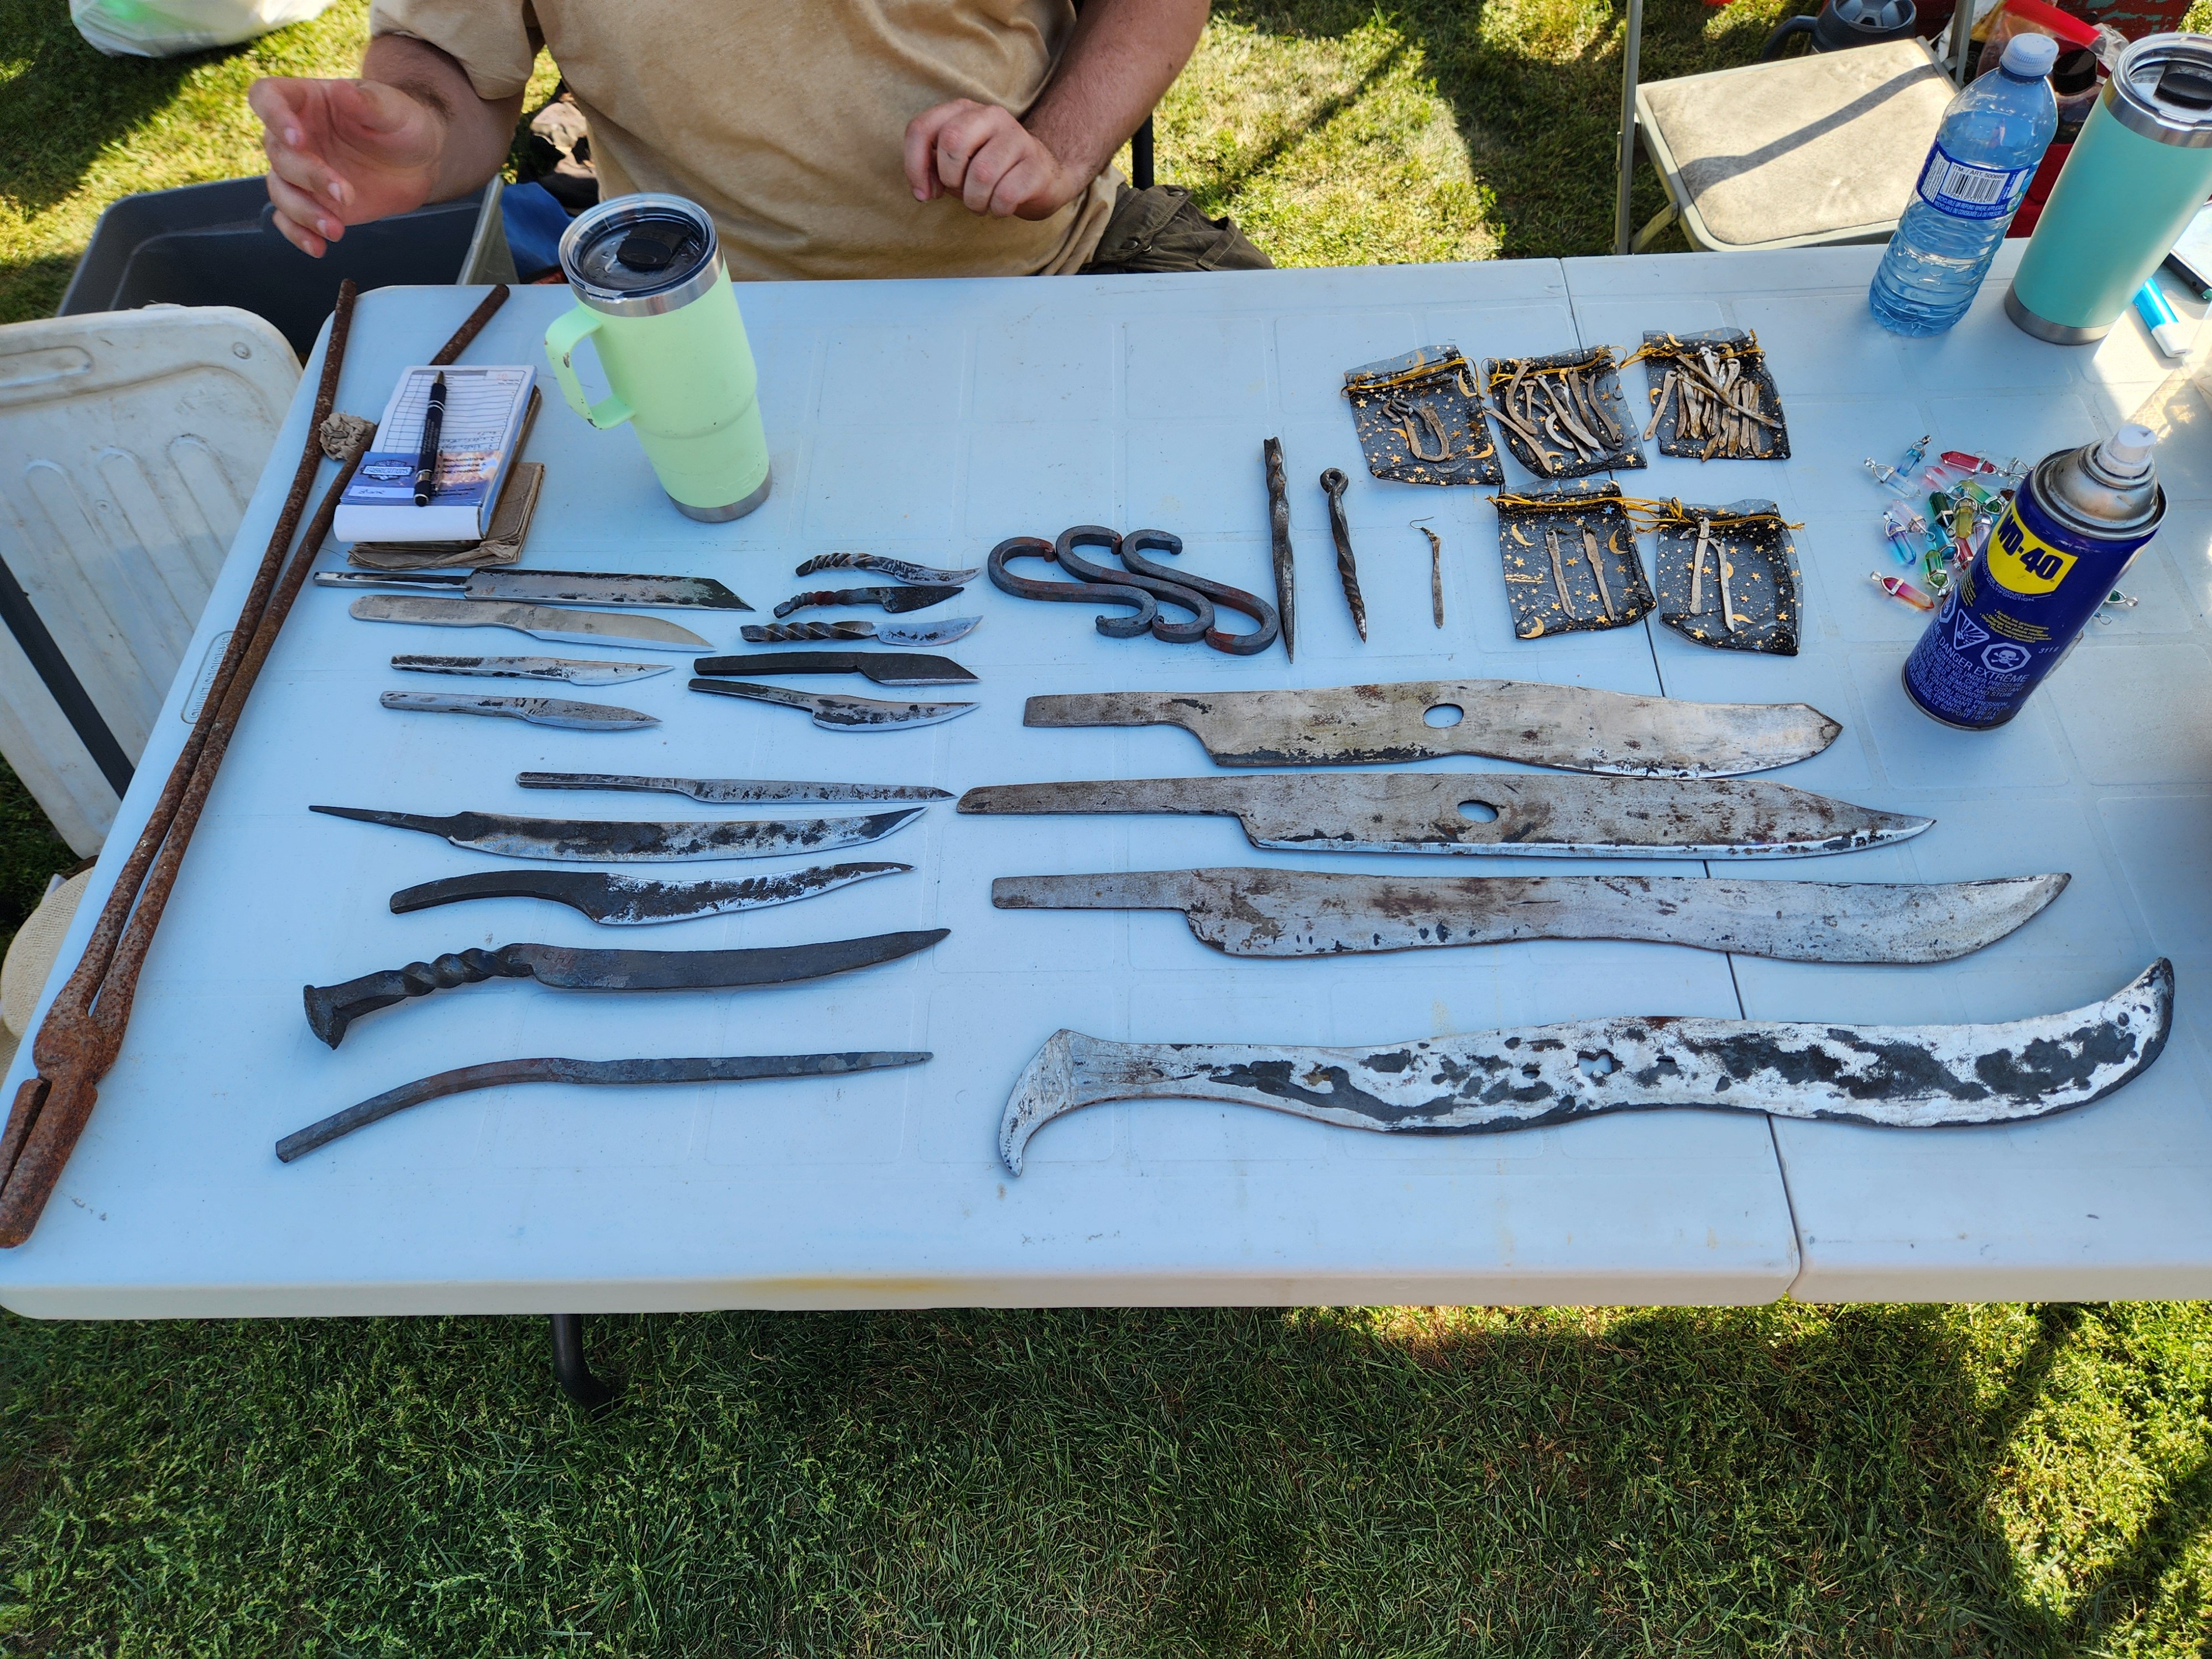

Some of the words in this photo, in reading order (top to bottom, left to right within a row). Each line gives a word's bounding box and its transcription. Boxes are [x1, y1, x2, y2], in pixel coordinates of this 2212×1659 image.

[1953, 165, 1964, 174] ITM.
[1934, 200, 1953, 212] RECYCLABLE
[1937, 195, 1955, 206] RECYCLABLE
[1997, 508, 2063, 580] WD-40
[1986, 577, 2034, 601] MULTIFONCTION
[1996, 584, 2025, 597] PRODUCT
[1938, 648, 1963, 673] CONTENTS
[1964, 671, 1986, 684] UNDER
[1939, 636, 1973, 670] DANGER
[1974, 666, 2030, 682] EXTRÊME
[1929, 674, 1954, 695] CONTENU
[1954, 693, 1973, 703] SOUS
[1931, 666, 1952, 686] HOLDER
[1952, 684, 1985, 701] PROVIDED.
[1933, 661, 1946, 677] USED.
[1948, 675, 1974, 691] REMOVE
[1951, 670, 1965, 680] NOT
[1965, 679, 2025, 692] CHILD-RESISTANT
[1918, 686, 1932, 700] DANS
[1932, 698, 1940, 706] LE
[1940, 704, 1971, 718] SUPPORT
[1927, 679, 1934, 687] LE
[1934, 686, 1971, 707] CONTENANT
